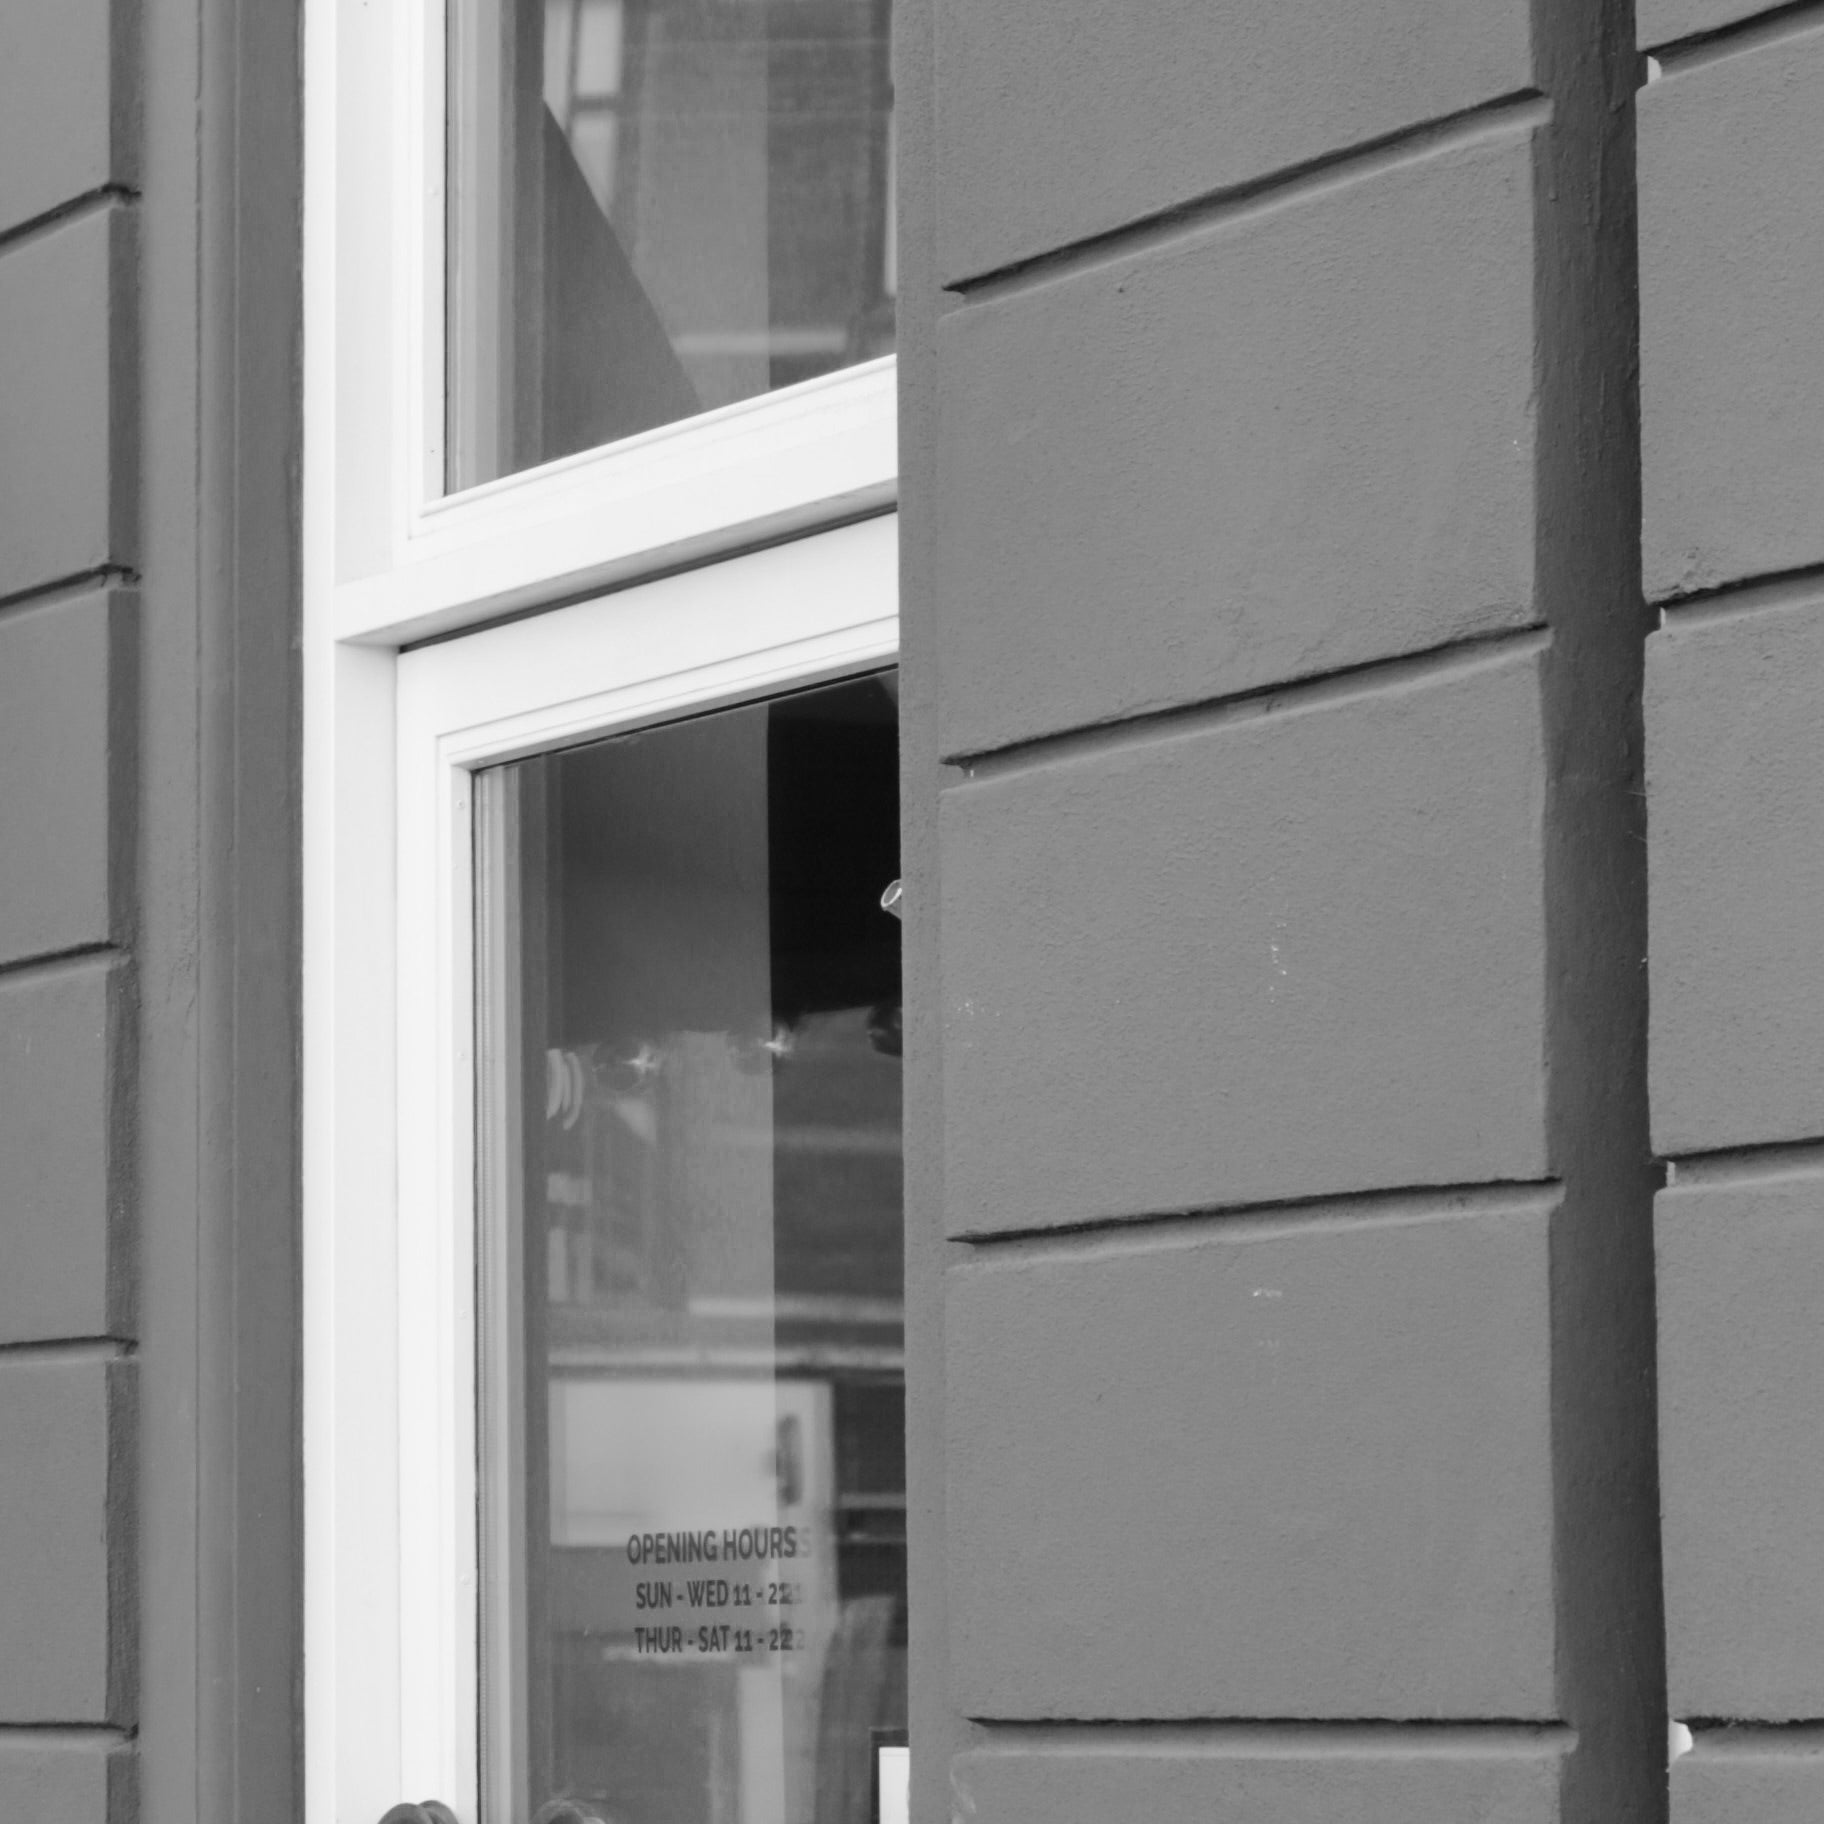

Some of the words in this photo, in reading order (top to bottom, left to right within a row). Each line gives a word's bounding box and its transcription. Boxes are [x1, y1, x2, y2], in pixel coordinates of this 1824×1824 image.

[627, 1530, 718, 1565] OPENING
[723, 1526, 797, 1560] HOURS
[636, 1581, 672, 1609] SUN
[687, 1579, 729, 1607] WED
[733, 1584, 752, 1606] 11
[635, 1626, 683, 1653] THUR
[698, 1625, 731, 1652] SAT
[735, 1630, 753, 1652] 11
